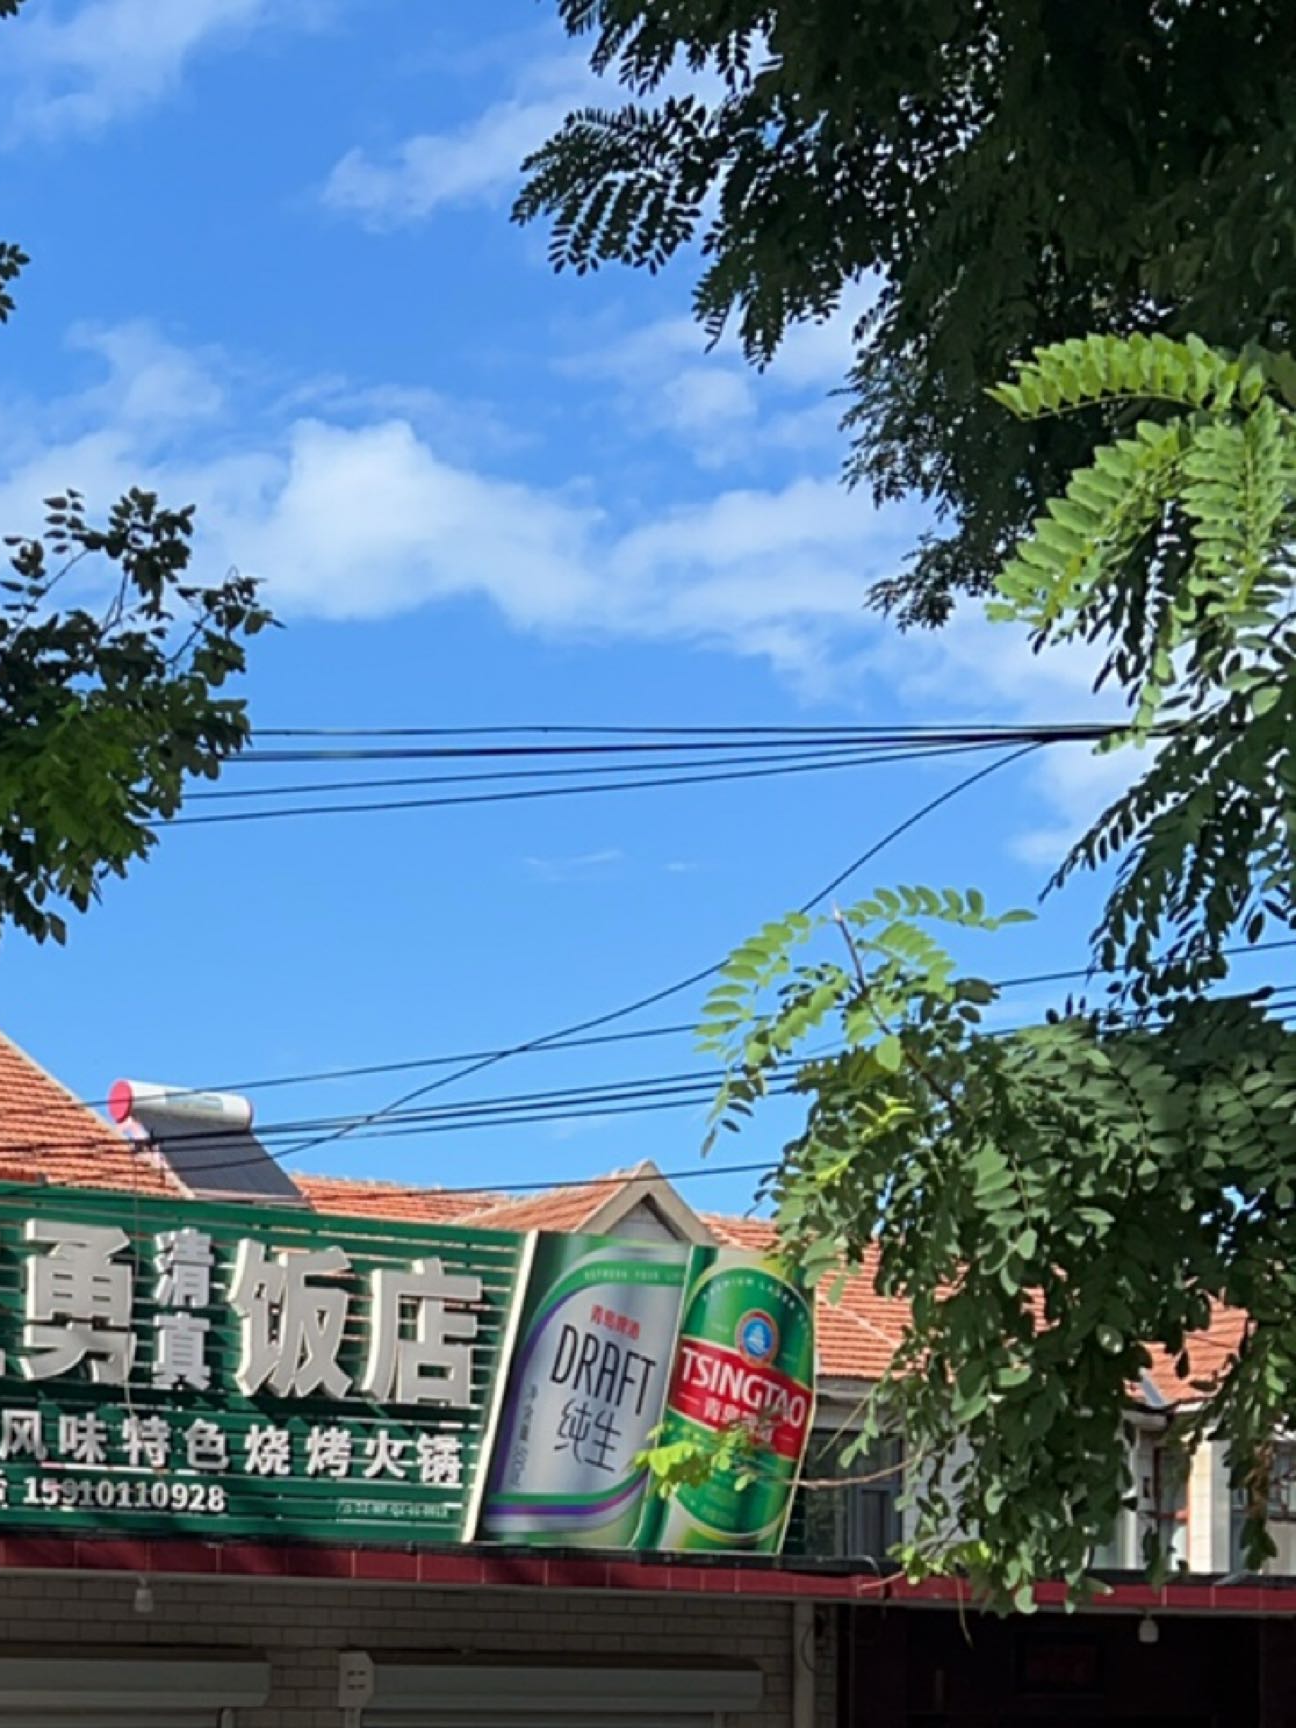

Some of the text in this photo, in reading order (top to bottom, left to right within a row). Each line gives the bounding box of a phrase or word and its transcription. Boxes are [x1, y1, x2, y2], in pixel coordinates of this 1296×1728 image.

[152, 1226, 215, 1391] 清真
[227, 1237, 482, 1405] 饭店
[550, 1323, 657, 1416] DRAFT
[682, 1347, 806, 1429] TSINGTAO
[553, 1397, 622, 1473] 纯生
[23, 1476, 226, 1512] 15910110928
